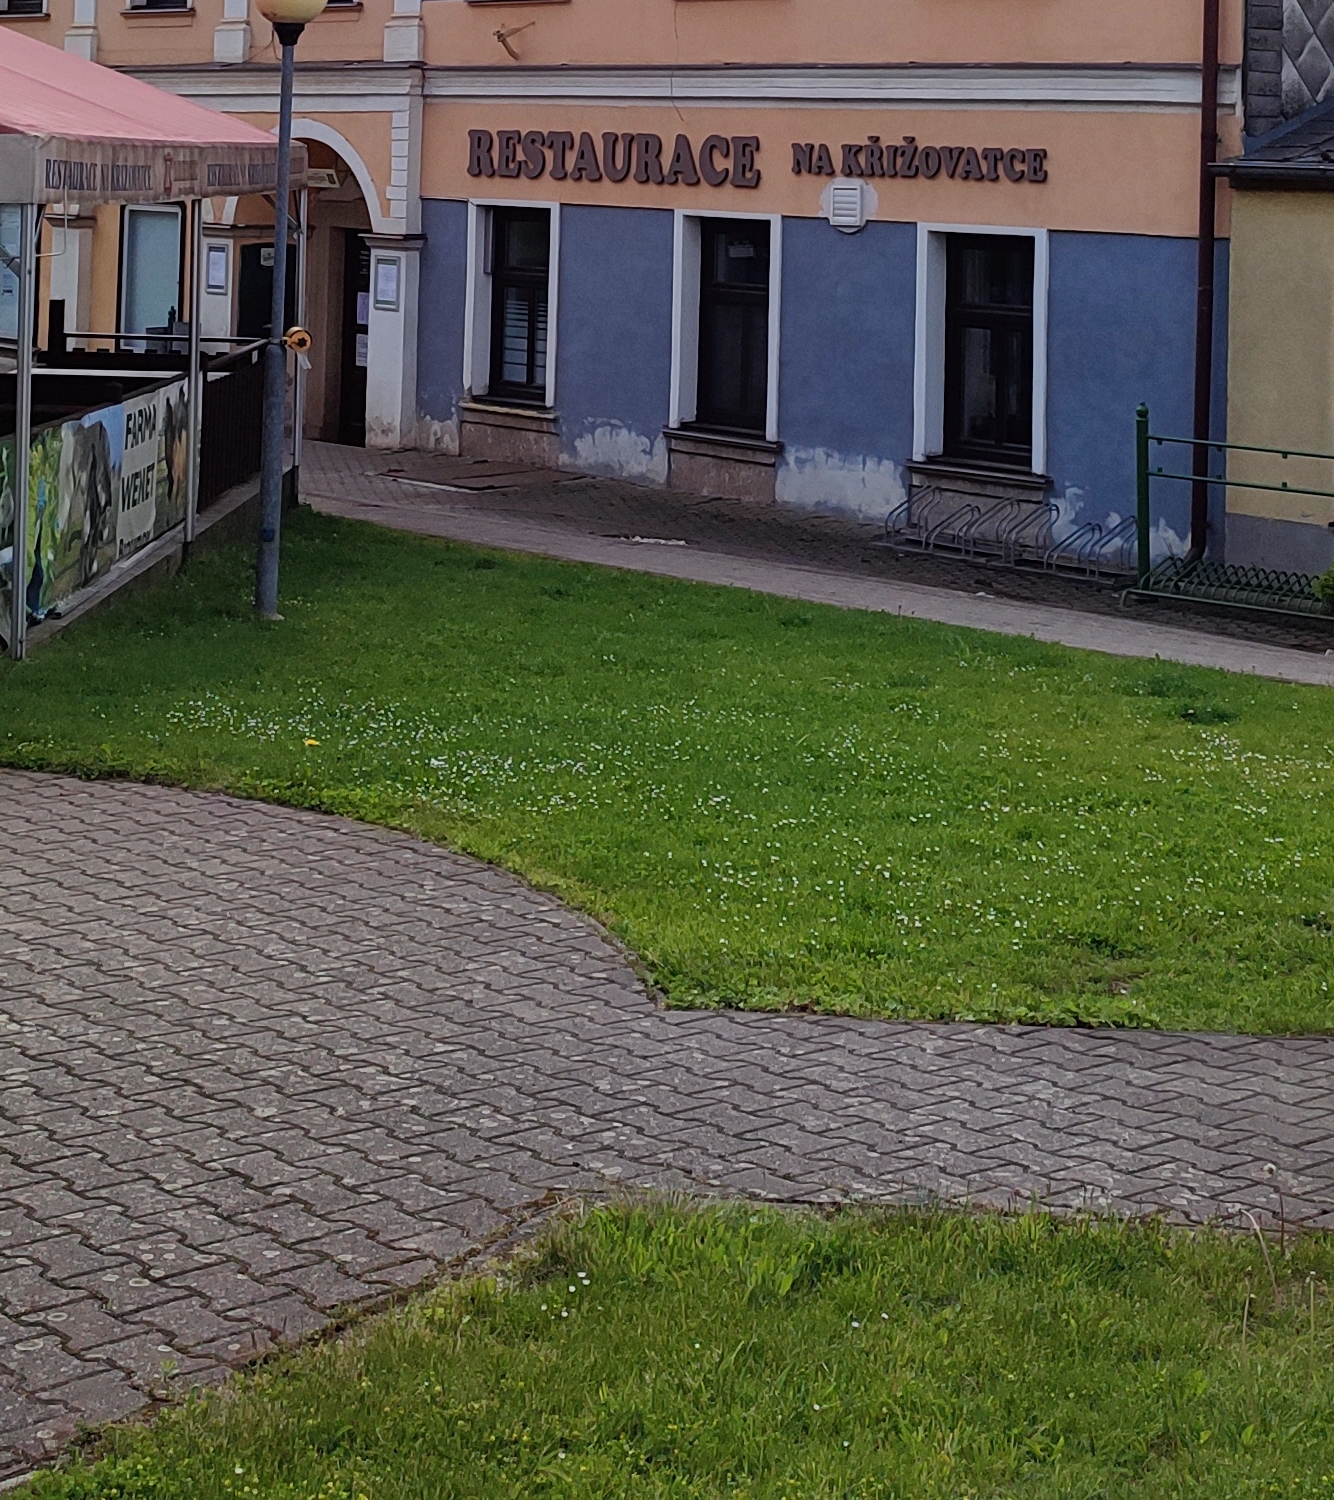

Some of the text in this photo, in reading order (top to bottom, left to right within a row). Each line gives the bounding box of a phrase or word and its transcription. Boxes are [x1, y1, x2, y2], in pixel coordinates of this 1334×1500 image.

[467, 129, 1048, 188] RESTAURACE NA KŘIŽOVATCE
[124, 403, 157, 451] FARMA
